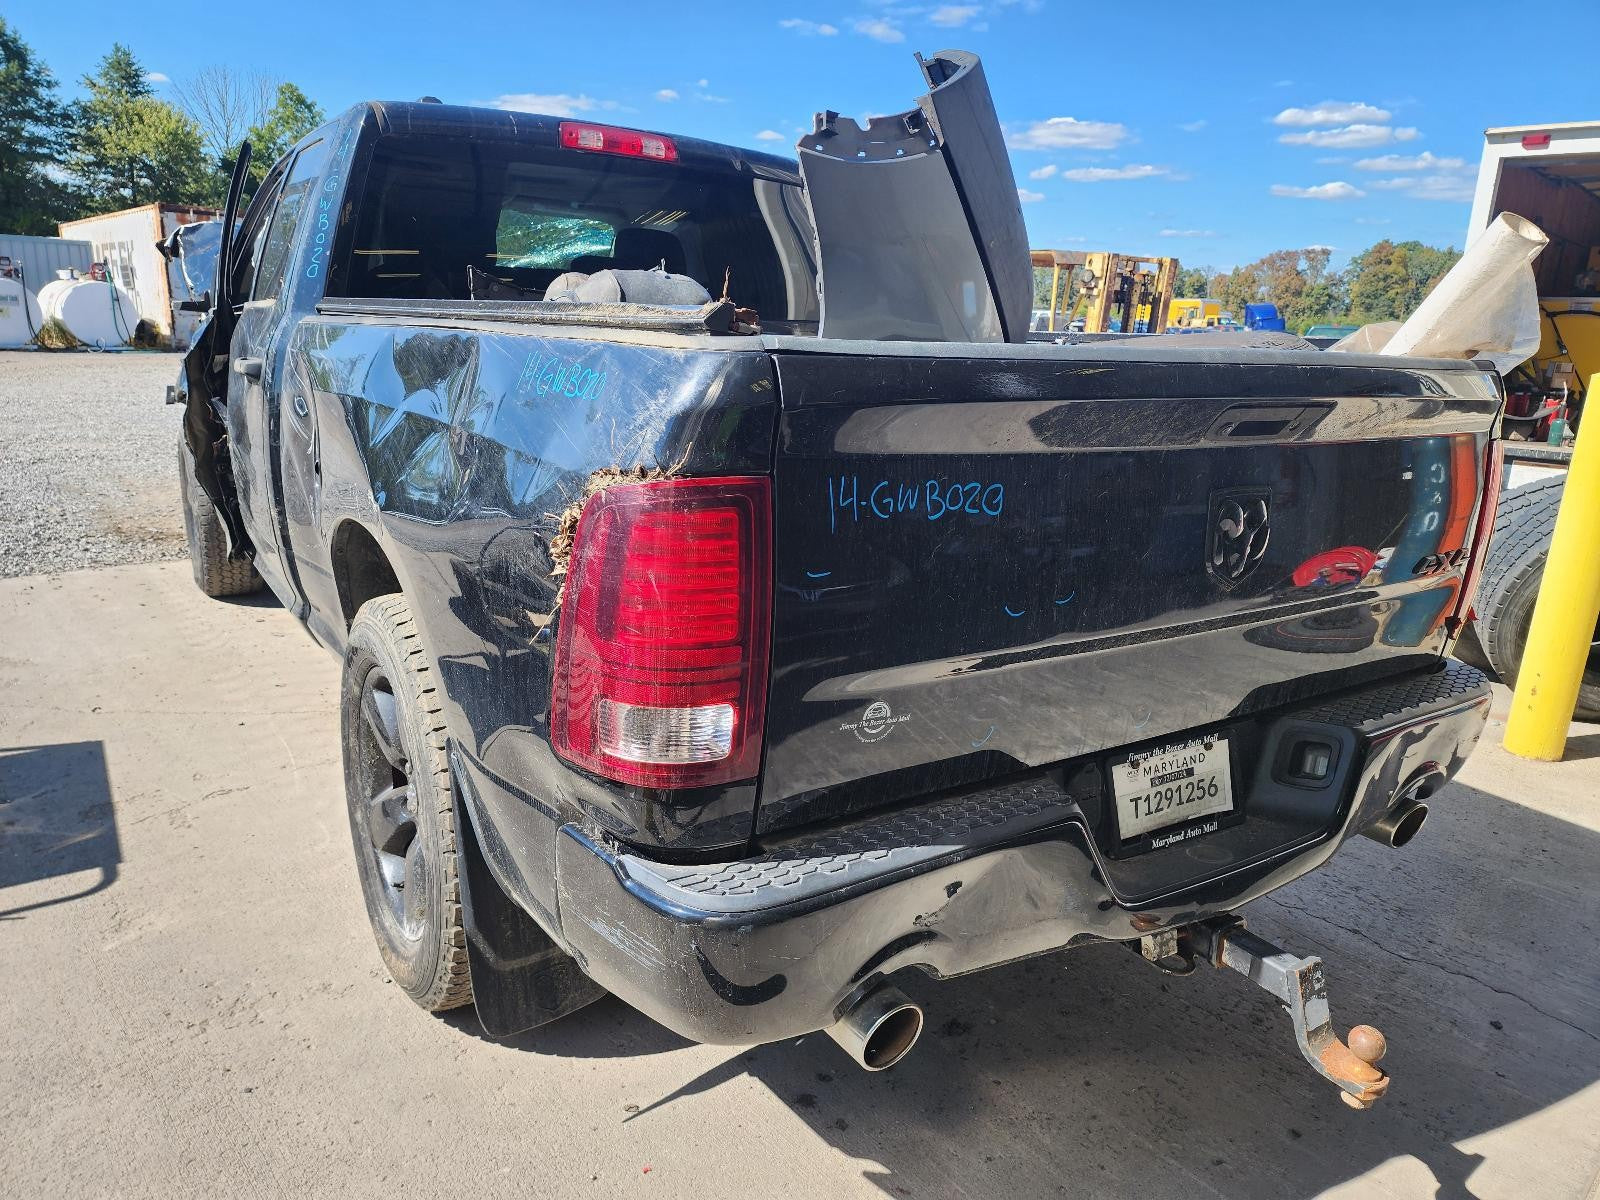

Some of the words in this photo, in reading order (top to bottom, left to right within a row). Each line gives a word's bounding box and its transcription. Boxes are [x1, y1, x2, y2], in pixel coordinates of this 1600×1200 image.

[1127, 751, 1152, 762] Jimmy
[1153, 747, 1163, 756] the
[1186, 739, 1201, 748] Auto
[1203, 733, 1218, 744] Mall
[1143, 753, 1206, 777] MARYLAND
[1129, 775, 1219, 819] T1291256
[1152, 831, 1185, 850] Maryland
[1186, 828, 1201, 839] Auto
[1203, 822, 1218, 833] Mall
